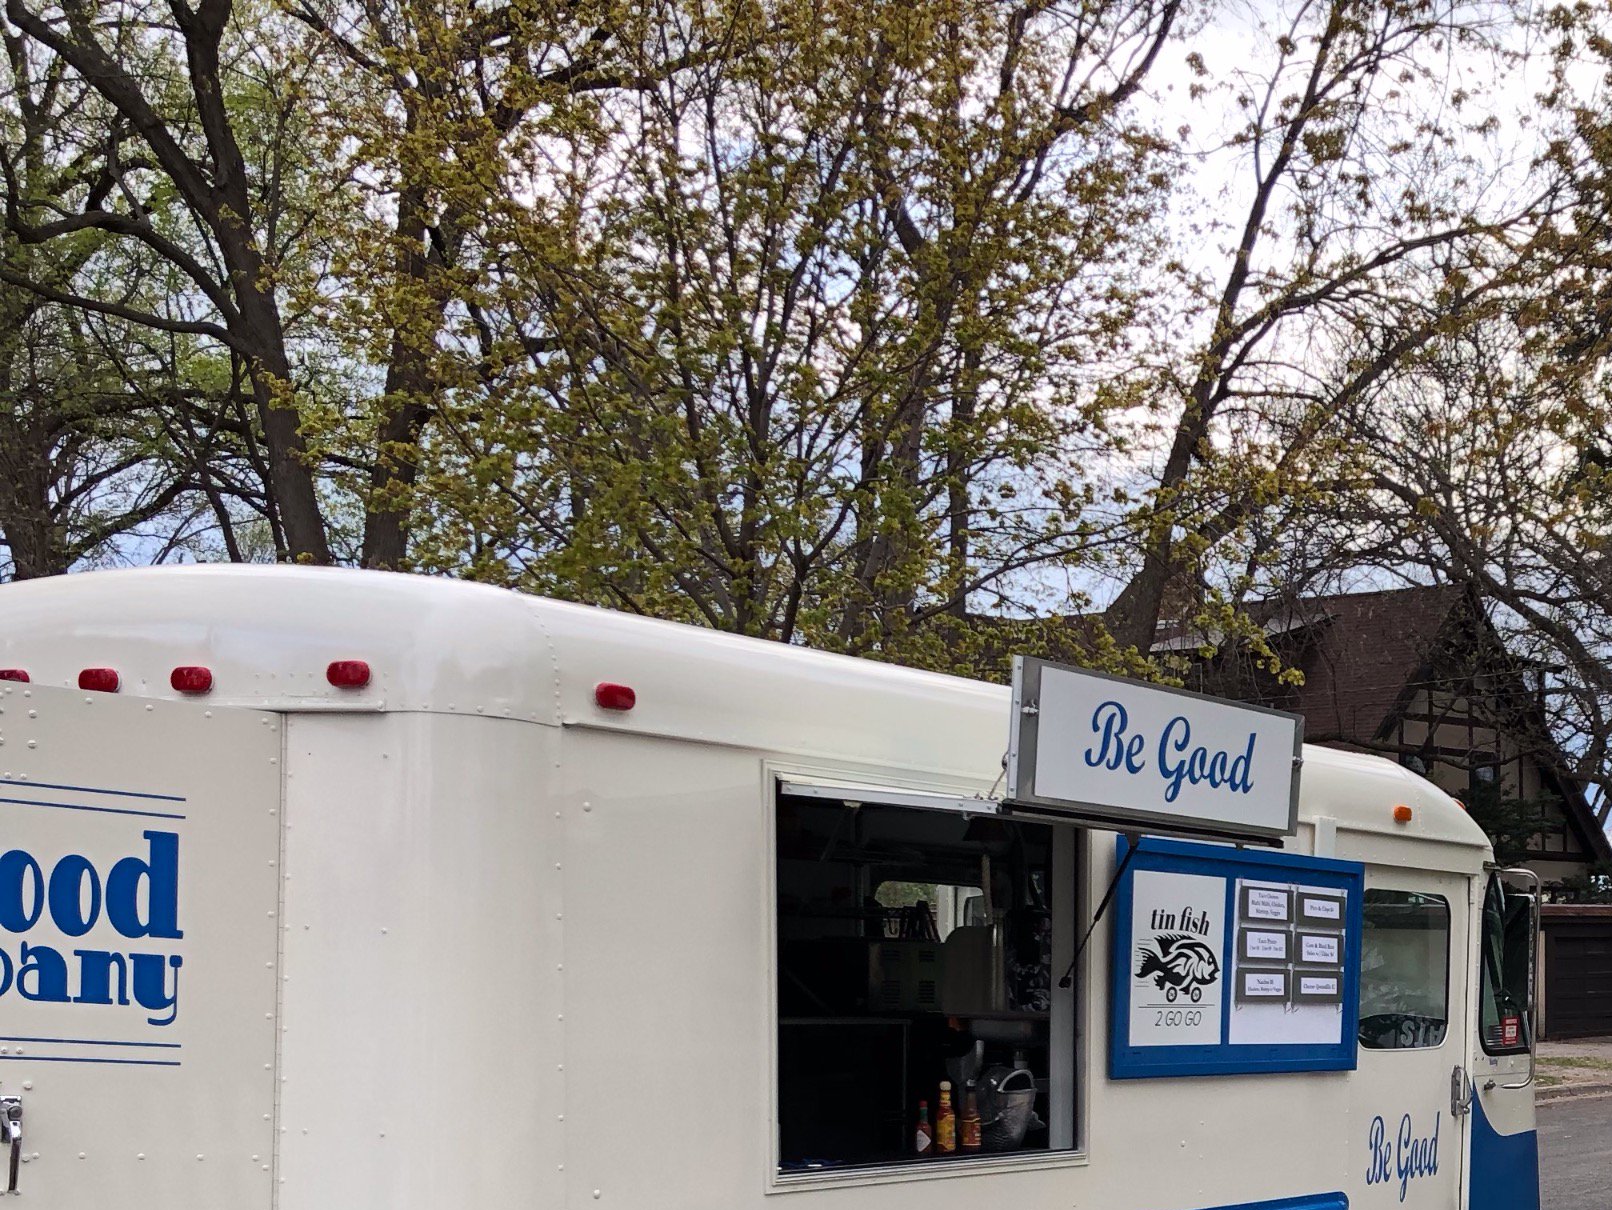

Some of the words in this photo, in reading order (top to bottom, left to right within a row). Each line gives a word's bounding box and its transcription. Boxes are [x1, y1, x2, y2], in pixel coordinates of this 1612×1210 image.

[1084, 701, 1145, 774] Be
[1158, 715, 1257, 803] Good
[1150, 908, 1175, 931] tin
[1178, 906, 1210, 936] fish
[0, 941, 183, 1026] any
[1154, 1010, 1163, 1027] 2
[1165, 1010, 1182, 1027] GO
[1184, 1010, 1202, 1027] GO
[1366, 1115, 1393, 1186] Be
[1396, 1111, 1441, 1203] Good
